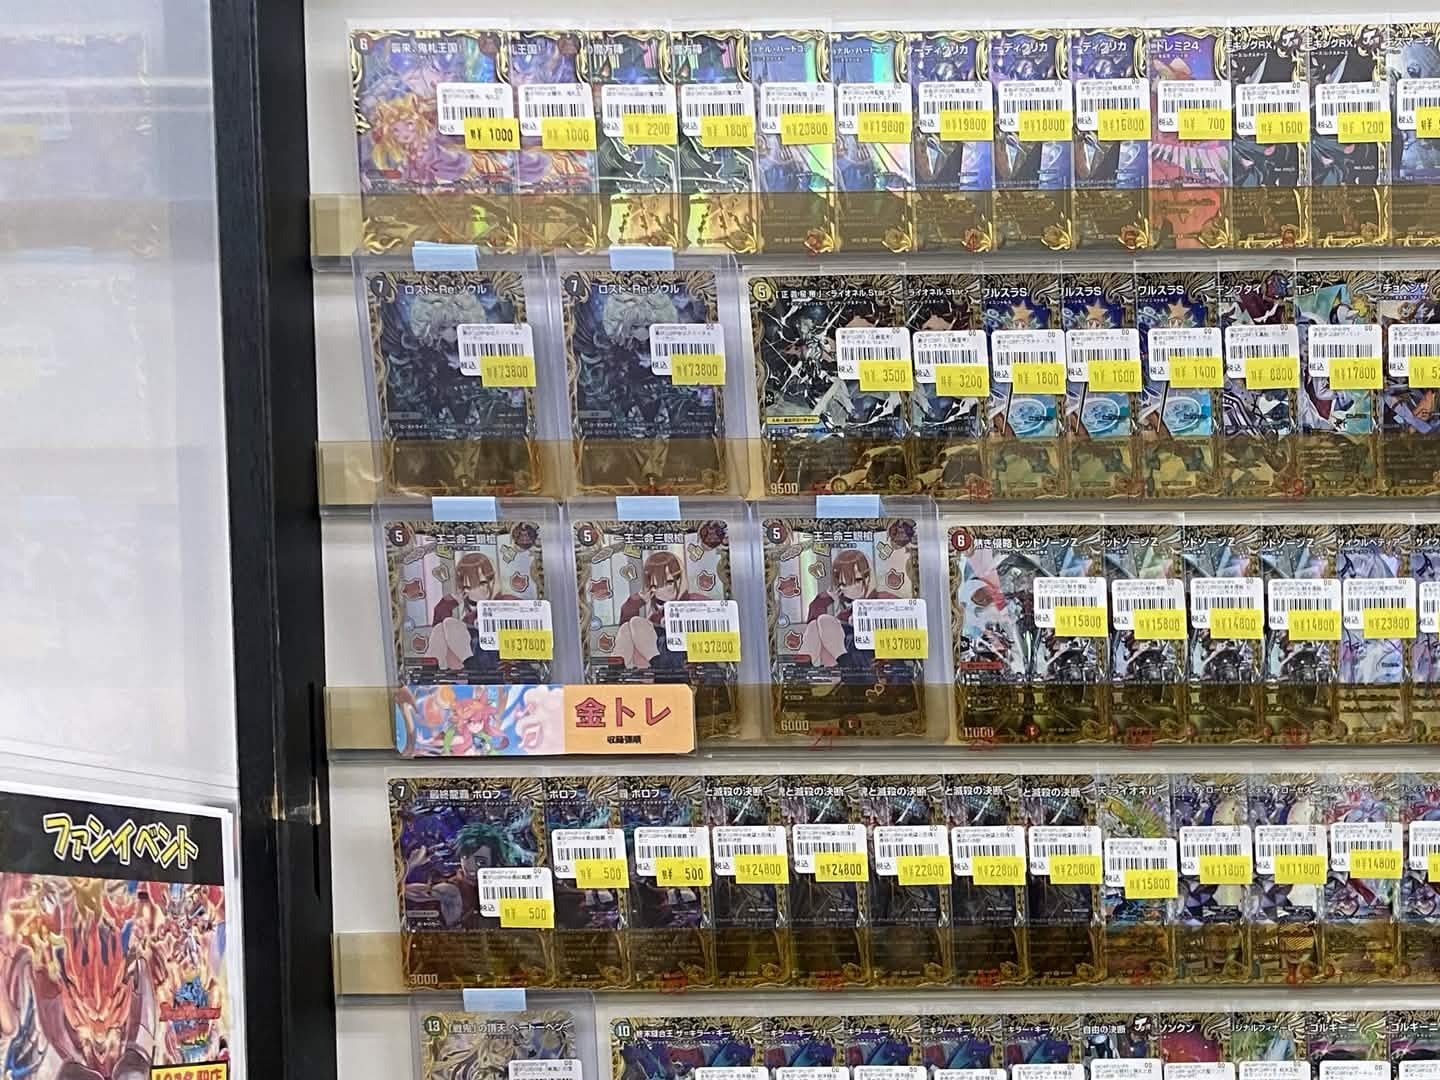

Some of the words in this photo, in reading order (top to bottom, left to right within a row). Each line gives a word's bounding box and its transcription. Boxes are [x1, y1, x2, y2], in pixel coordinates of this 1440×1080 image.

[757, 286, 767, 297] 5
[395, 530, 403, 541] 5
[772, 529, 781, 540] 5
[957, 534, 965, 547] 6
[575, 696, 671, 728] 金トレ
[44, 813, 198, 867] ファンイベント
